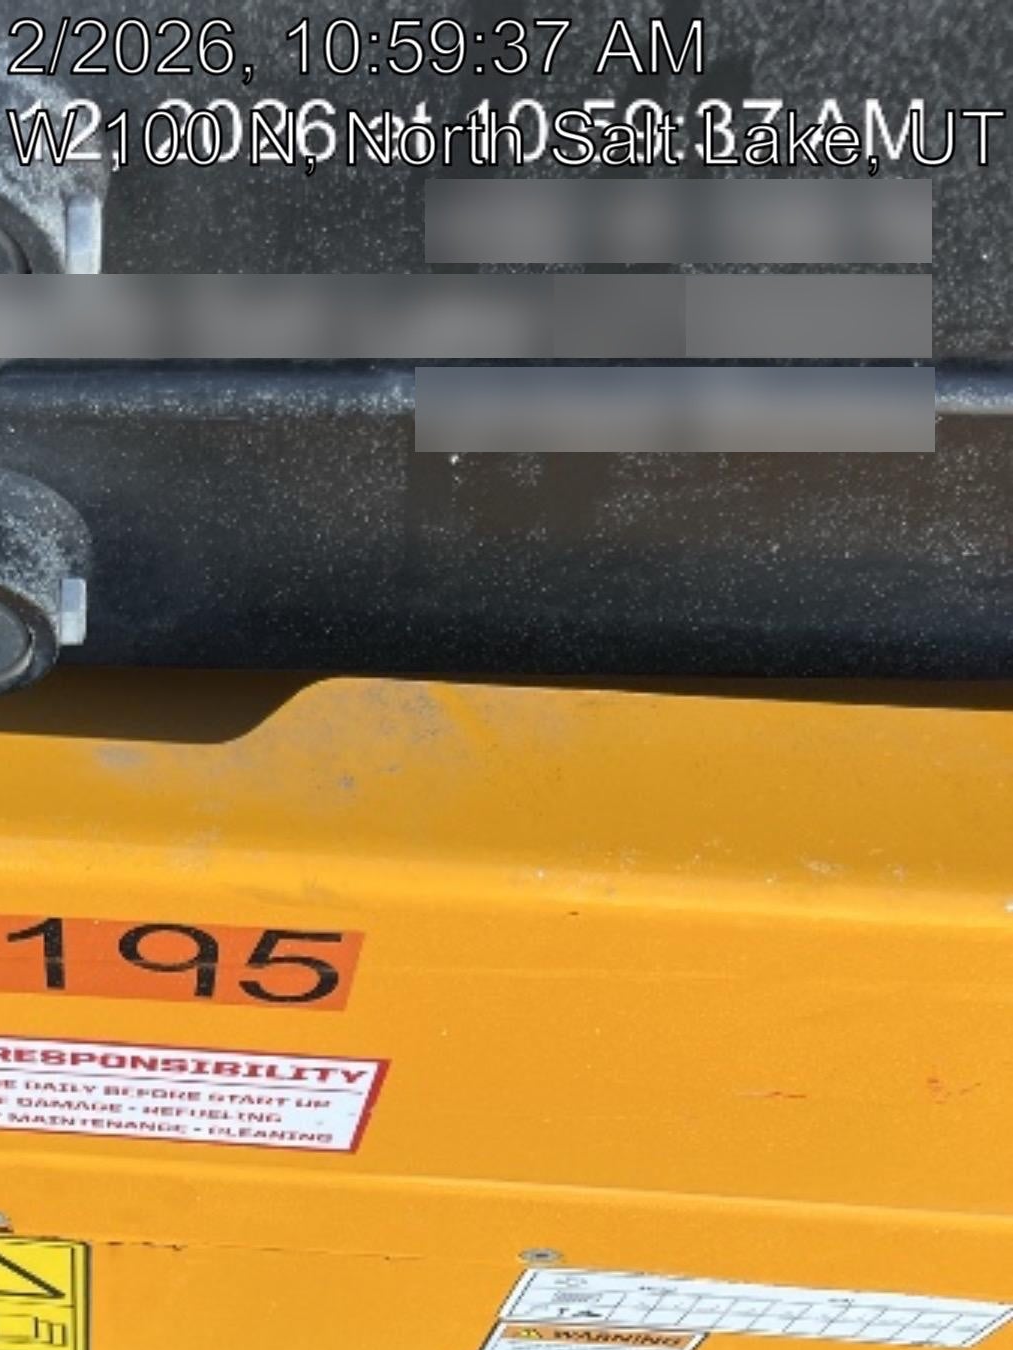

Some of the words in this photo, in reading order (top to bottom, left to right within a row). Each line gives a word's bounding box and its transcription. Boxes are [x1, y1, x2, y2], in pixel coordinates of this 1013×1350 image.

[25, 1080, 98, 1094] DAILY
[208, 1092, 291, 1106] START
[17, 1096, 123, 1113] DAMAGE
[553, 1329, 683, 1348] WARNING
